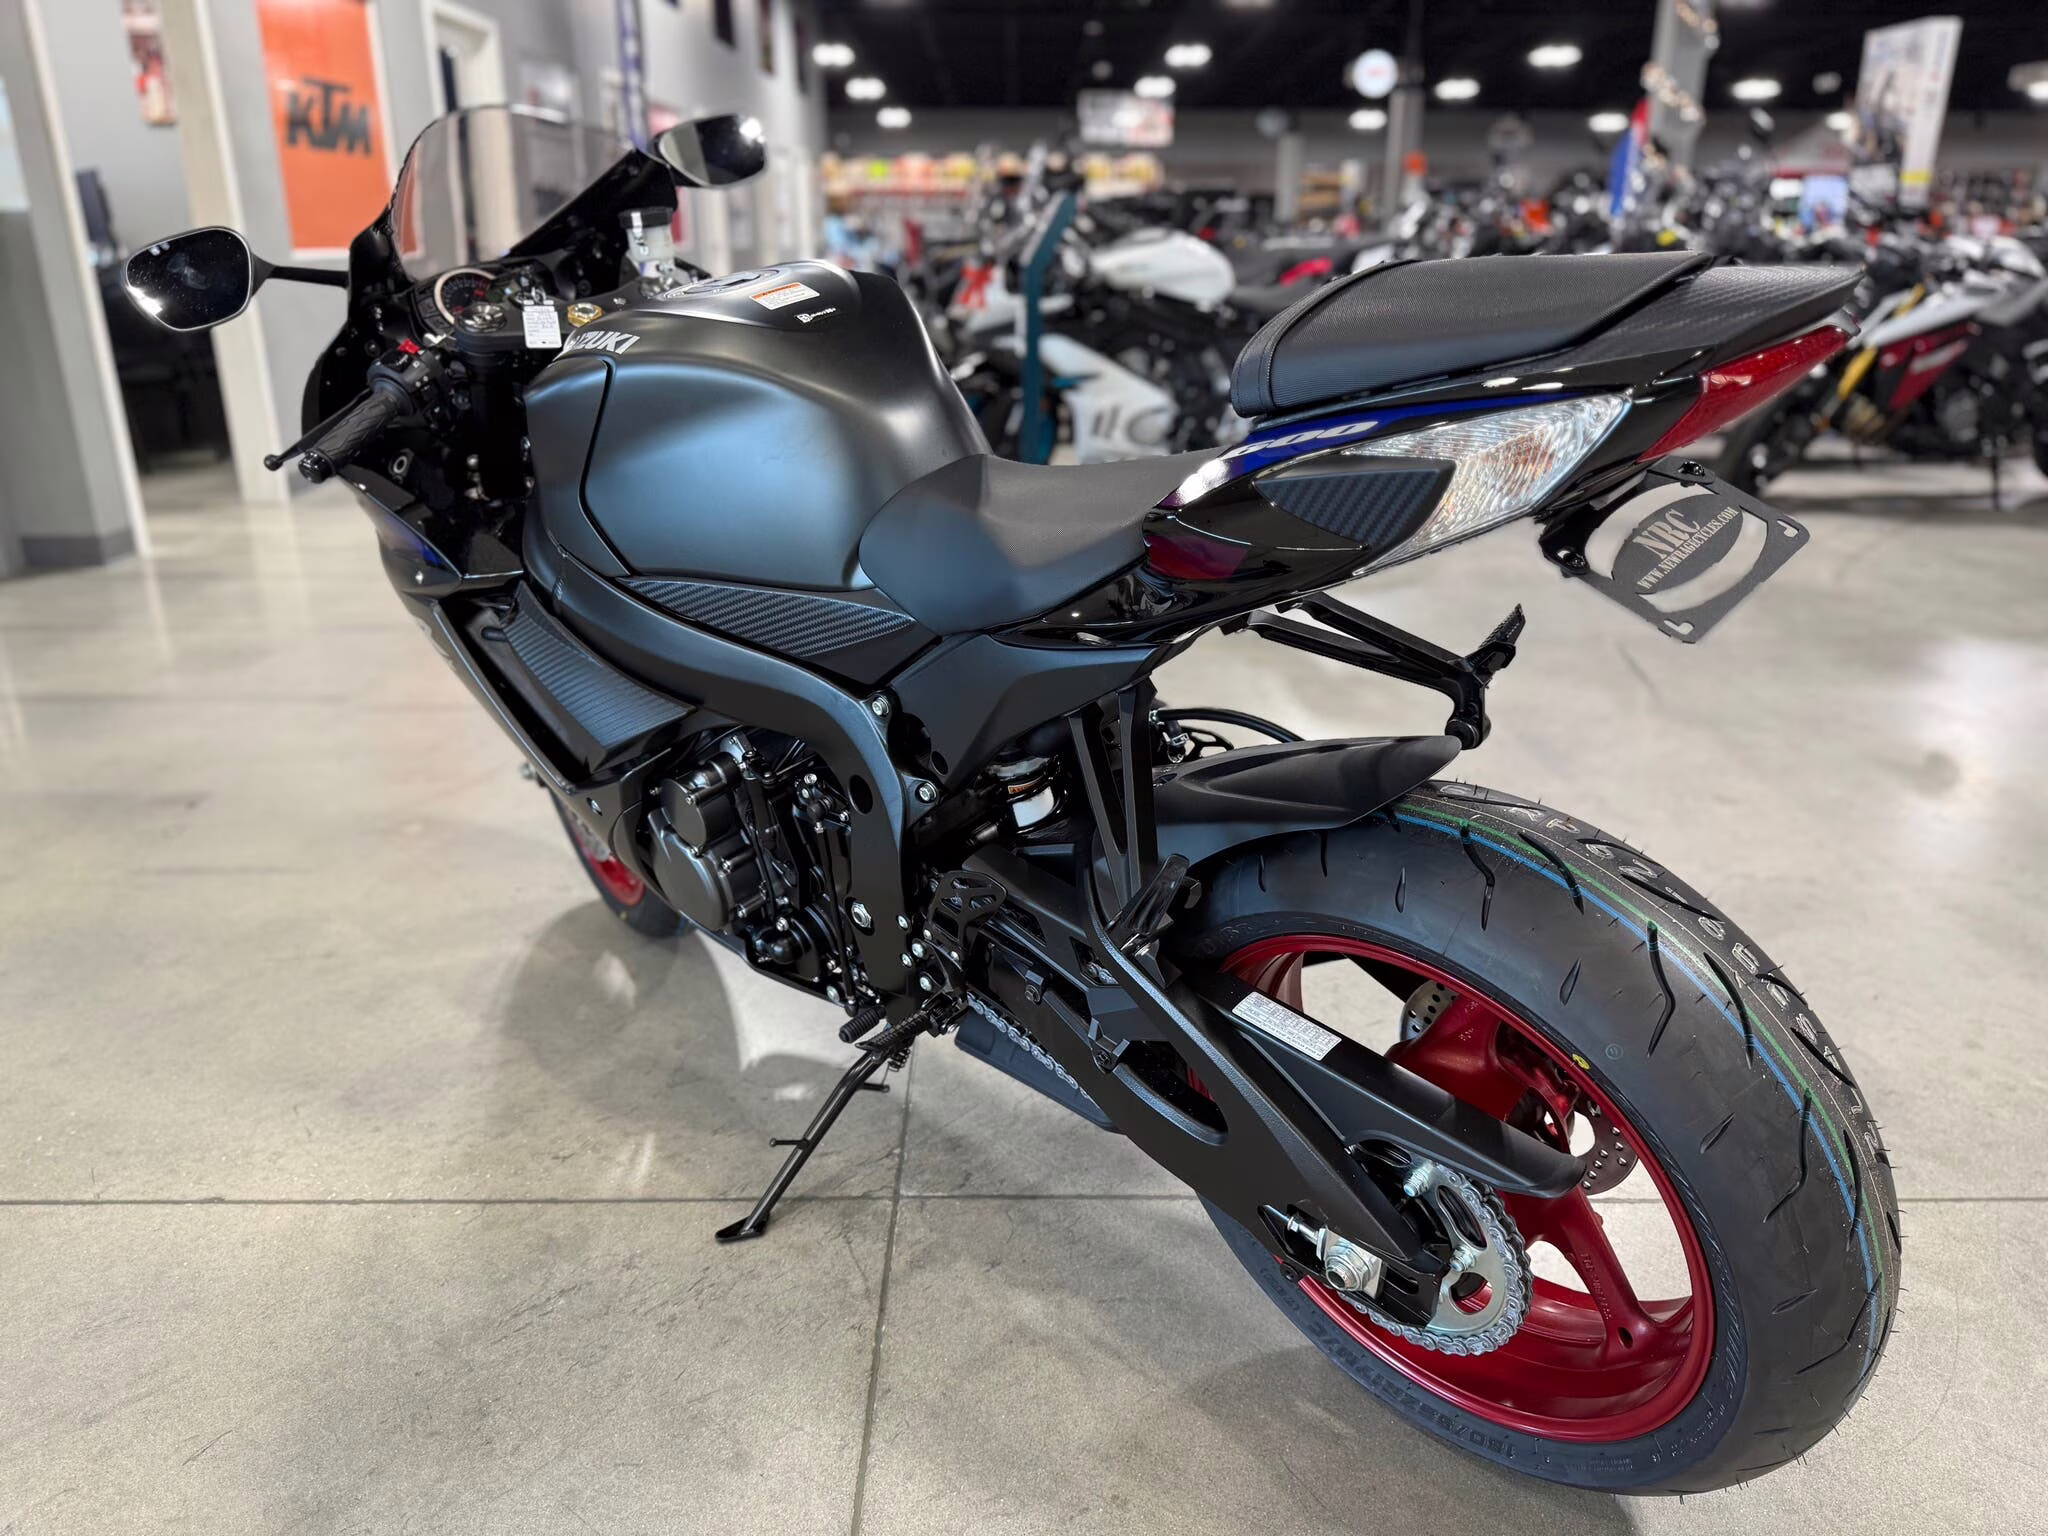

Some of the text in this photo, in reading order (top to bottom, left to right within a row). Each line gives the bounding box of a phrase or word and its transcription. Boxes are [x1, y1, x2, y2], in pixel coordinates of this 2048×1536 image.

[287, 76, 371, 156] KTM
[1218, 421, 1379, 460] 600
[1632, 508, 1701, 560] NRC
[1636, 506, 1739, 590] WWW.NEWRAGECYCLES.COM
